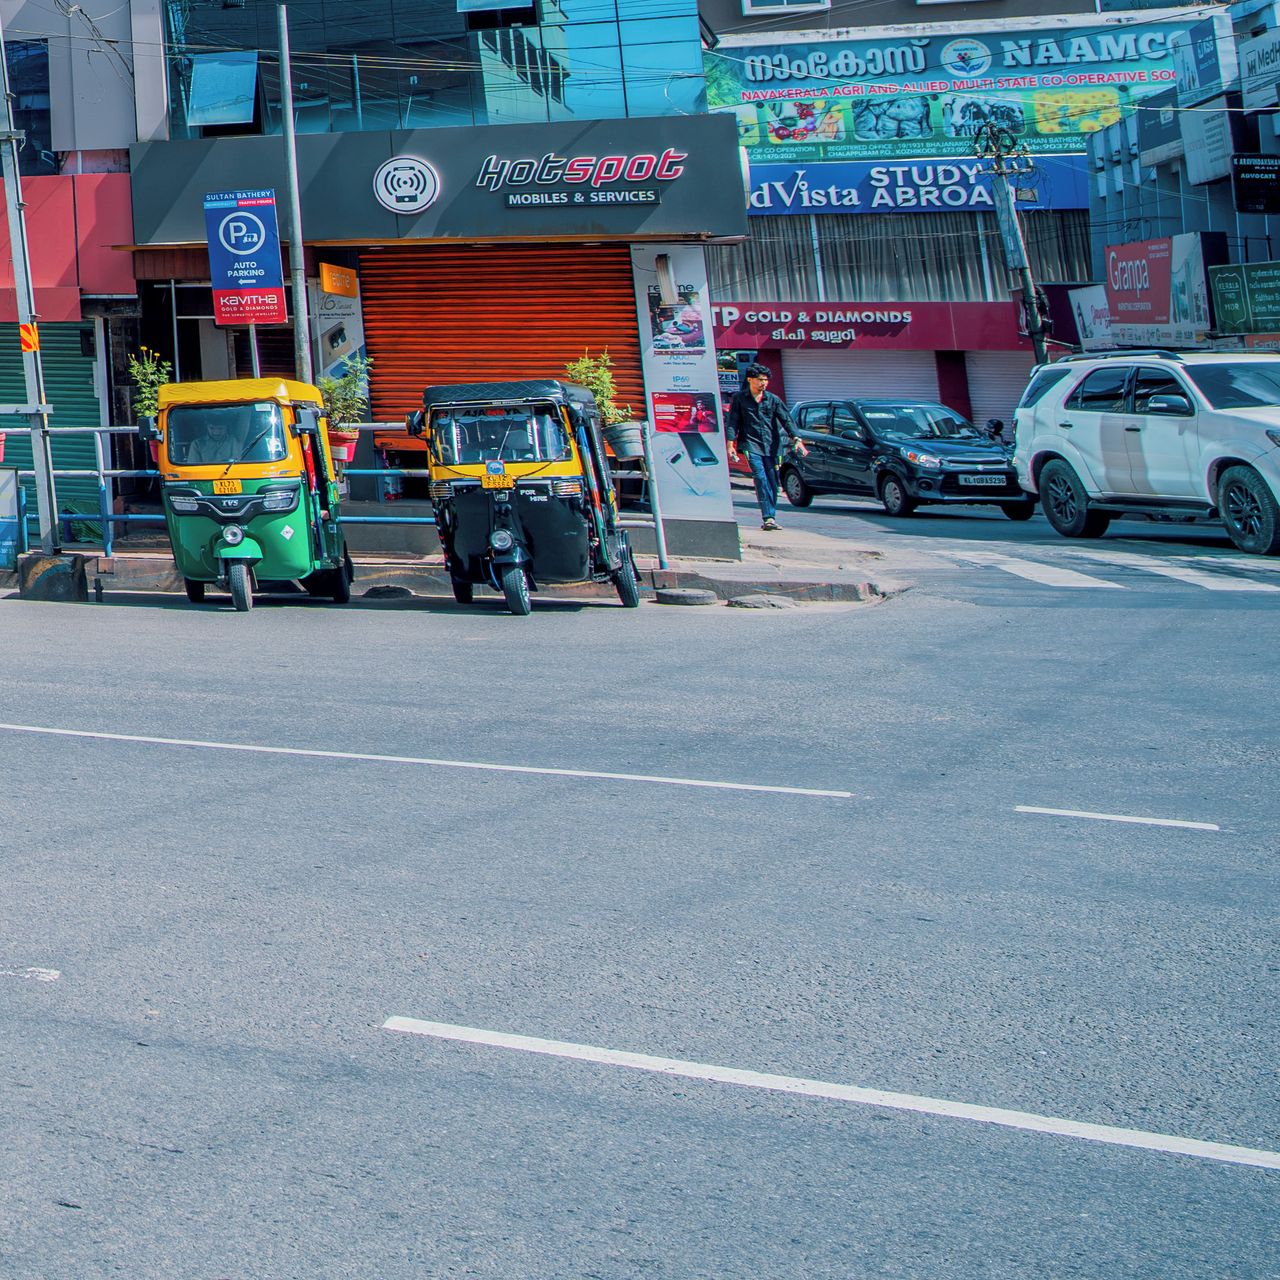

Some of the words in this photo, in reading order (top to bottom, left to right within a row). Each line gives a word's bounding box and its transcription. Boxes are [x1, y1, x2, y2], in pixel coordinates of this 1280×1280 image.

[742, 87, 828, 101] NAVAKERALA
[832, 85, 864, 96] AGRI
[868, 83, 898, 94] AND
[902, 81, 949, 93] ALLIED
[953, 79, 994, 90] MULTI
[997, 77, 1037, 88] STATE
[1041, 71, 1146, 86] CO-OPERATIVE
[870, 165, 977, 186] STUDY
[237, 191, 271, 199] BATHERY
[508, 191, 568, 205] MOBILES
[573, 191, 585, 204] &
[590, 190, 655, 203] SERVICES
[871, 184, 1017, 209] ABROA
[227, 269, 265, 277] PARKING
[1110, 251, 1150, 298] Granpa
[648, 283, 694, 293] reme
[745, 311, 791, 323] GOLD
[797, 311, 810, 323] &
[815, 310, 913, 323] DIAMONDS
[221, 499, 239, 507] TVS
